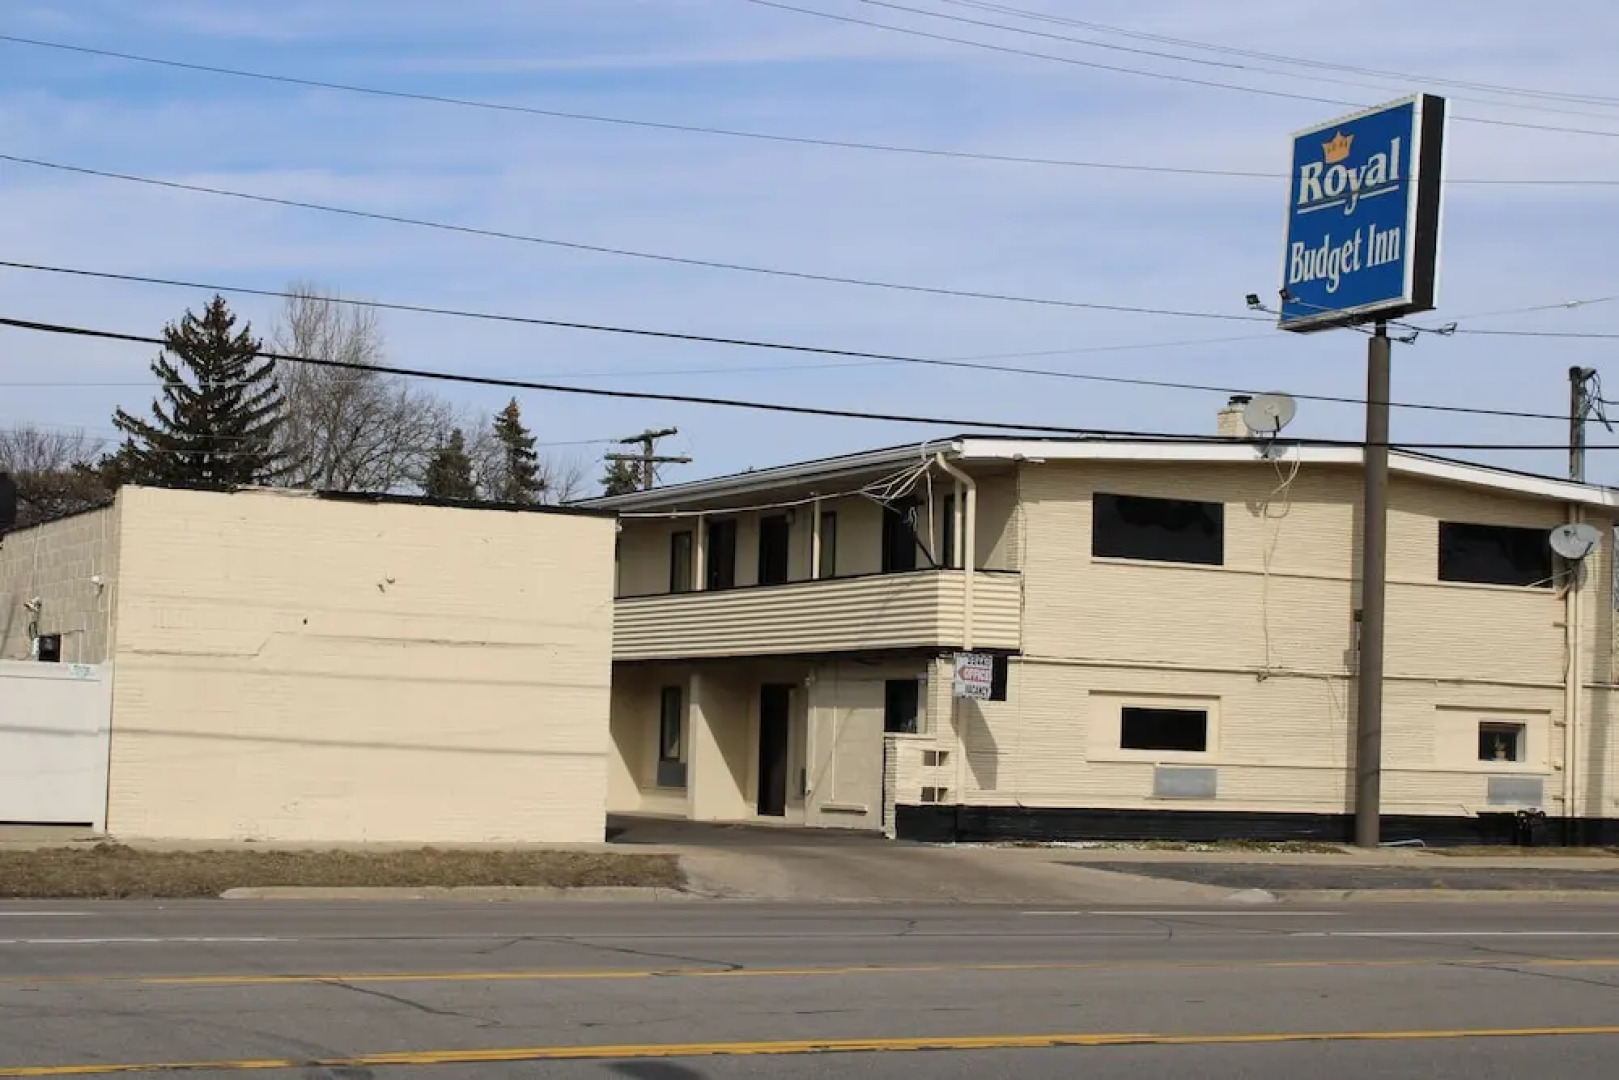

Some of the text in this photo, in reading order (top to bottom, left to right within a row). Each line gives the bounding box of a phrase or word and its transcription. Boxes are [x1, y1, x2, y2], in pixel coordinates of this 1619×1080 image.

[1297, 136, 1400, 215] Royal
[1289, 223, 1400, 293] Budget Inn
